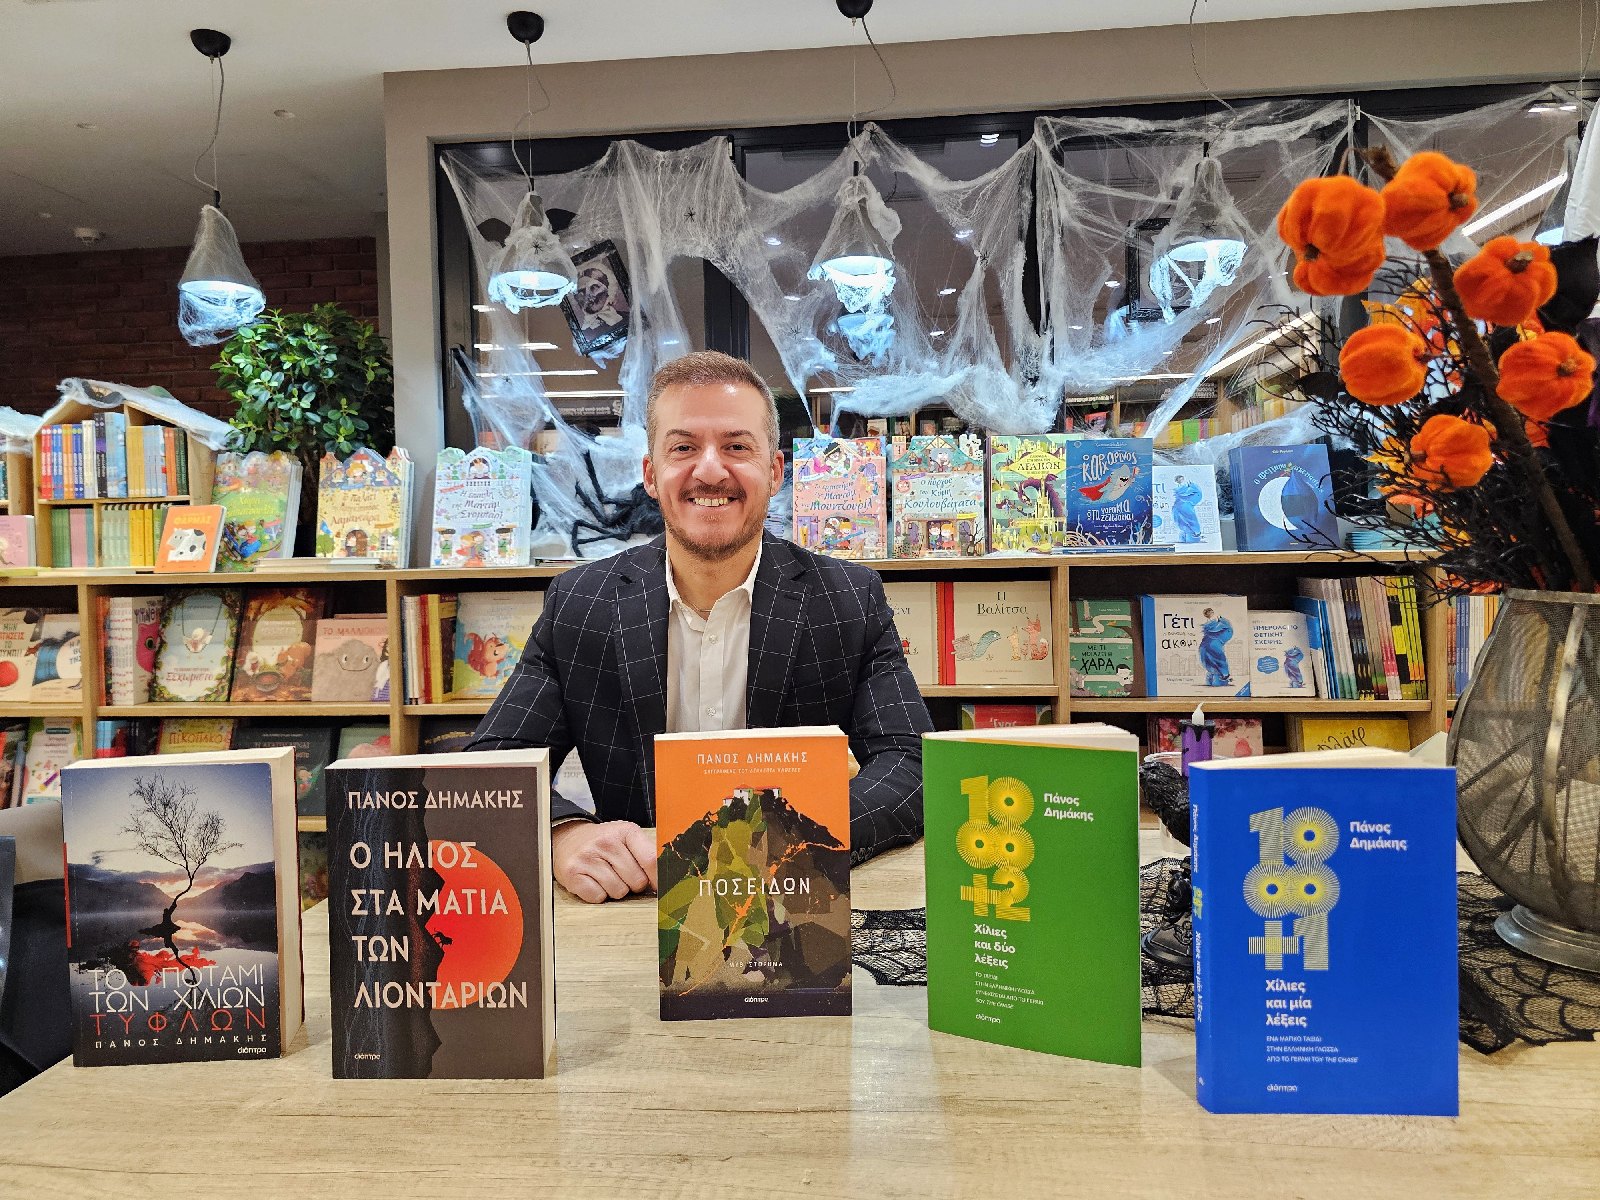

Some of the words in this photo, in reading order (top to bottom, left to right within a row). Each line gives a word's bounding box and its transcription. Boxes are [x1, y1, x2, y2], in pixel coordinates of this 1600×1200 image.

[976, 602, 1028, 615] Βαλίτσα
[1163, 614, 1194, 629] Γέτι
[1080, 658, 1115, 674] ΧΑΡΑ
[697, 753, 738, 764] ΠΑΝΟΣ
[746, 752, 808, 764] ΔΗΜΑΚΗΣ
[348, 790, 419, 809] ΠΑΝΟΣ
[424, 790, 523, 809] ΔΗΜΑΚΗΣ
[1044, 792, 1080, 807] Πάνος
[1044, 806, 1094, 822] Δημάκης
[1349, 820, 1391, 836] Πάνος
[1349, 836, 1407, 851] Δημάκης
[350, 842, 372, 870] Ο
[384, 840, 478, 869] ΗΛΙΟΣ
[698, 877, 811, 897] ΠΟΣΕΙΔΩΝ
[351, 889, 404, 916] ΣΤΑ
[416, 888, 509, 915] ΜΑΤΙΑ
[974, 923, 1008, 940] Χίλιες
[352, 936, 409, 962] ΤΩΝ
[974, 940, 992, 951] και
[994, 941, 1016, 954] δύο
[974, 953, 1009, 970] λέξεις
[88, 968, 128, 991] ΤΟ
[162, 964, 264, 989] ΠΟΤΑΜΙ
[1265, 978, 1306, 994] Χίλιες
[88, 990, 149, 1014] ΤΩΝ
[173, 986, 265, 1011] ΧΙΛΙΩΝ
[353, 981, 529, 1008] ΛΙΟΝΤΑΡΙΩΝ
[1266, 999, 1287, 1009] και
[1289, 995, 1312, 1011] μία
[89, 1008, 266, 1036] ΤΥΦΛΩΝ
[1265, 1012, 1307, 1028] λέξεις
[95, 1038, 159, 1049] ΠΑΝΟΣ
[176, 1034, 267, 1045] ΔΗΜΑΚΗΣ
